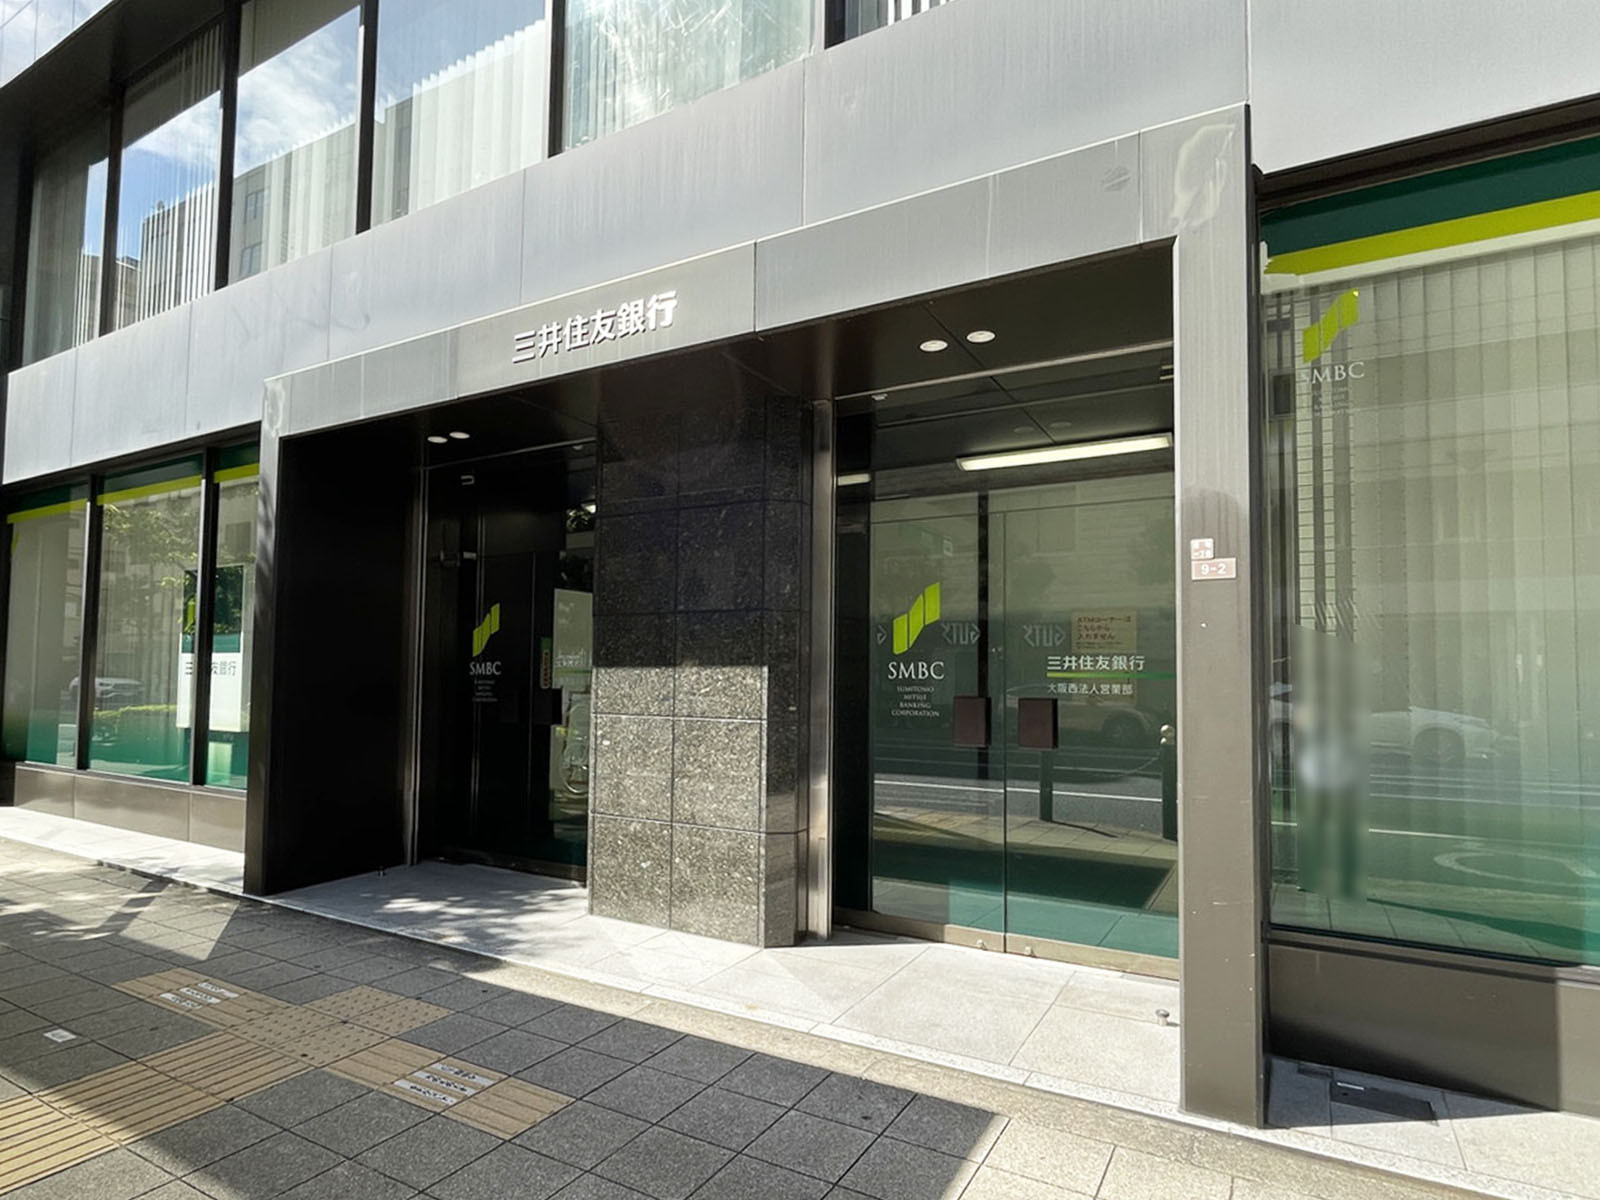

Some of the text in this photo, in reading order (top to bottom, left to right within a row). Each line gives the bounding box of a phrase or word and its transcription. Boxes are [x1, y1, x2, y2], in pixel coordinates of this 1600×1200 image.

[512, 290, 678, 364] 三井住友銀行
[469, 661, 502, 676] SMBC
[887, 661, 945, 680] SMBC
[1047, 655, 1146, 671] 三井住友銀行
